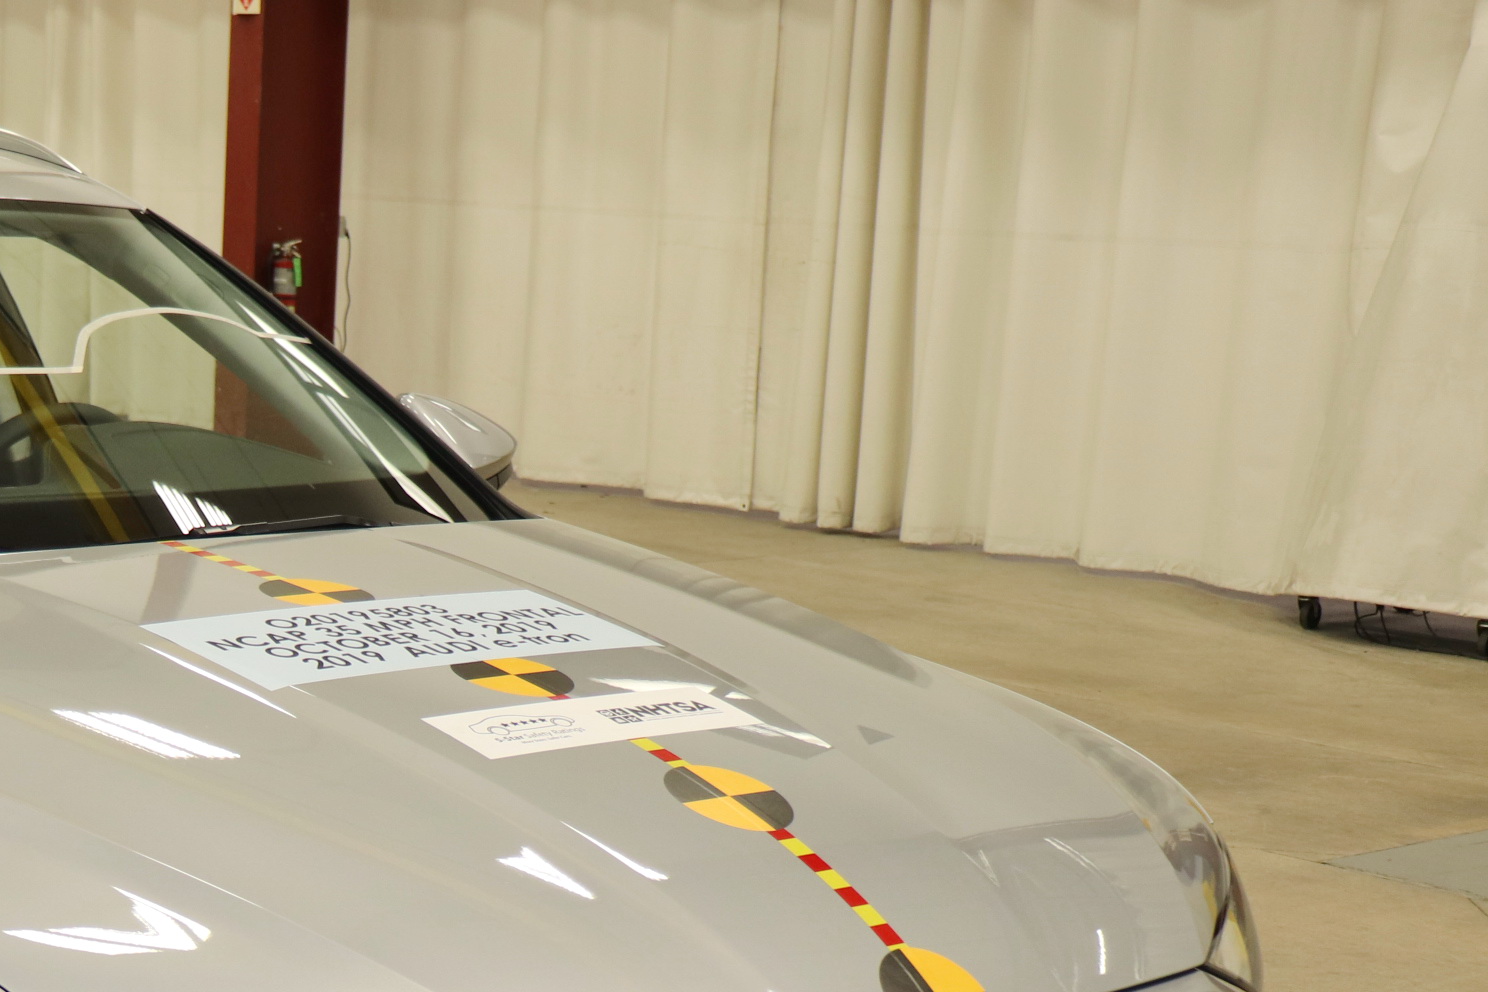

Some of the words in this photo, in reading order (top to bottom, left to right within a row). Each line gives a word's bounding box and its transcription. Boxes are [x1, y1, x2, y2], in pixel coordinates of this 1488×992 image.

[206, 630, 311, 651] NCAP
[314, 624, 362, 637] 35
[361, 617, 444, 633] MPH
[440, 606, 584, 624] FRONTAL
[264, 604, 449, 629] O20195803
[264, 632, 431, 658] OCTOBER
[428, 627, 487, 640] 16,
[481, 620, 558, 635] 2019
[302, 650, 385, 669] 2019
[403, 640, 492, 658] AUDI
[492, 632, 591, 648] e-tron
[623, 700, 718, 717] NHTSA
